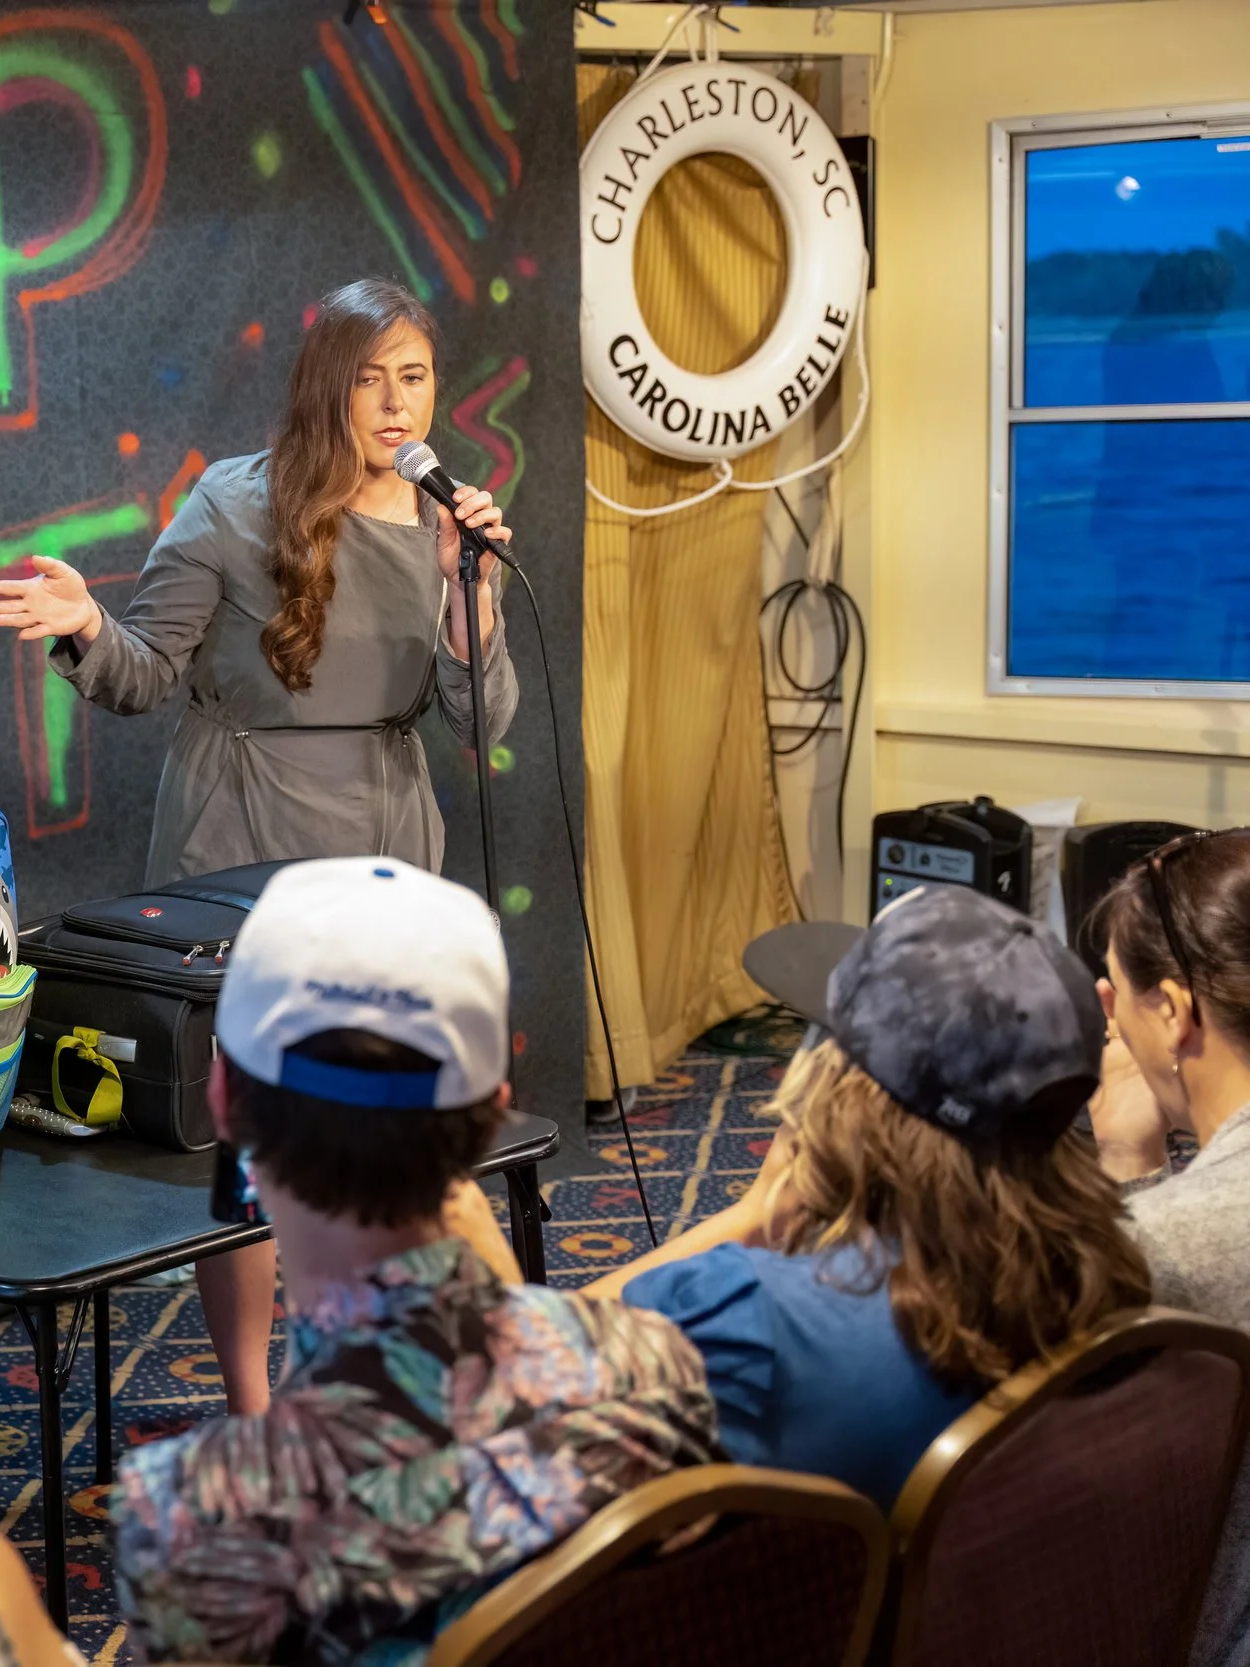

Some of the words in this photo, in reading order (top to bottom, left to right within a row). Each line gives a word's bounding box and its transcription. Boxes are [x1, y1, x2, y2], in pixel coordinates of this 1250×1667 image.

[591, 79, 807, 244] CHARLESTON,
[813, 159, 850, 218] SC
[609, 334, 771, 446] CAROLINA
[778, 305, 851, 419] BELLE
